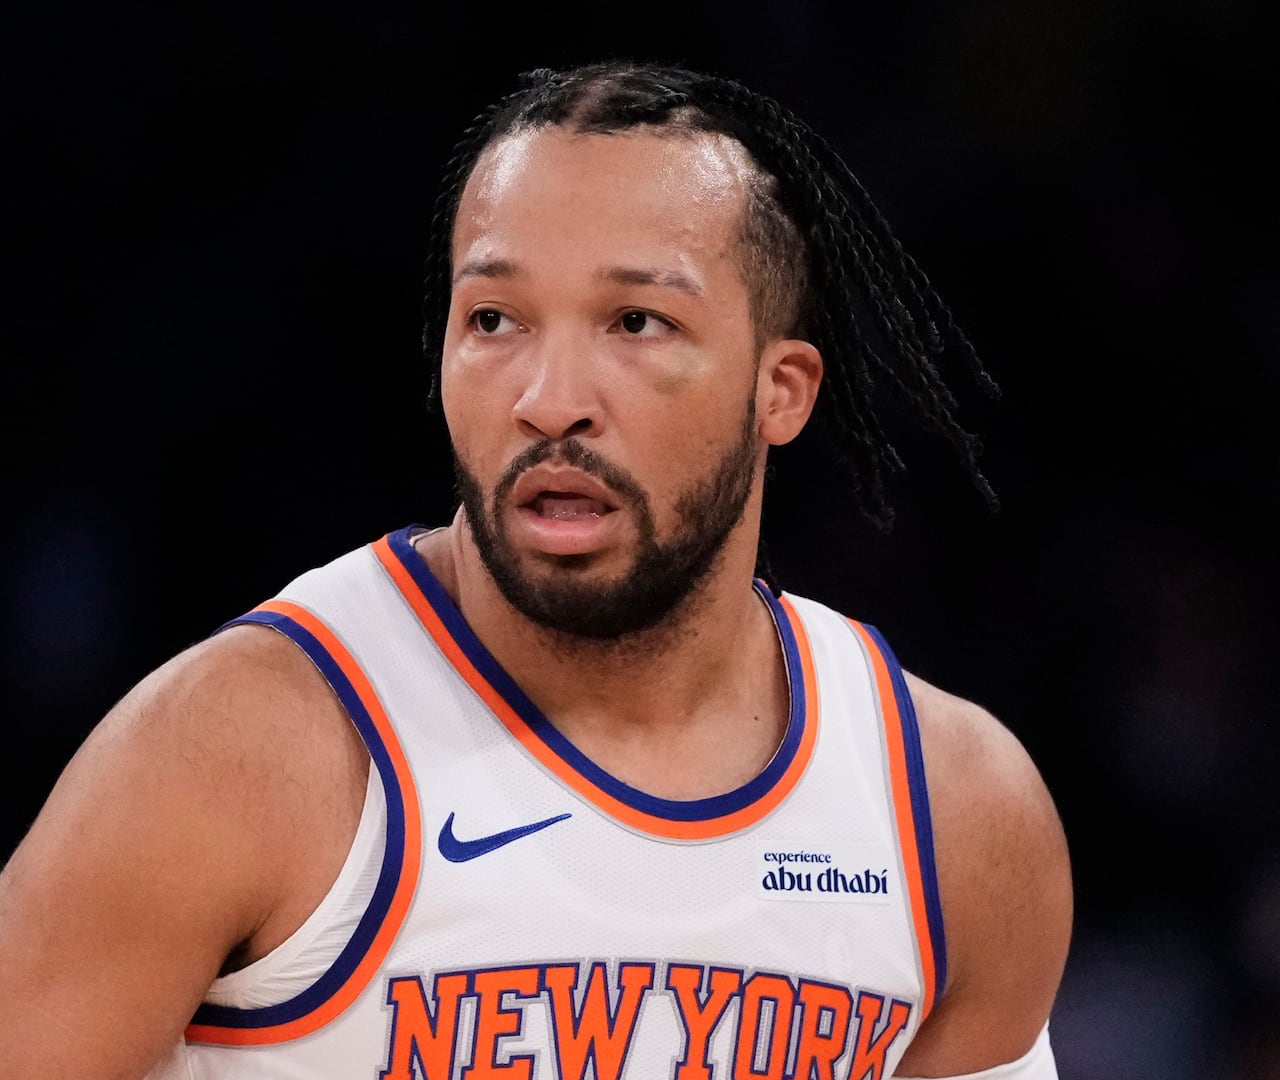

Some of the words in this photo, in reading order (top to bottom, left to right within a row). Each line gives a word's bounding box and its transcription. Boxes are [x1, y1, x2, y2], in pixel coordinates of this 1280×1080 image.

[764, 850, 832, 864] experience
[762, 866, 812, 891] abu
[817, 867, 888, 894] dhabi
